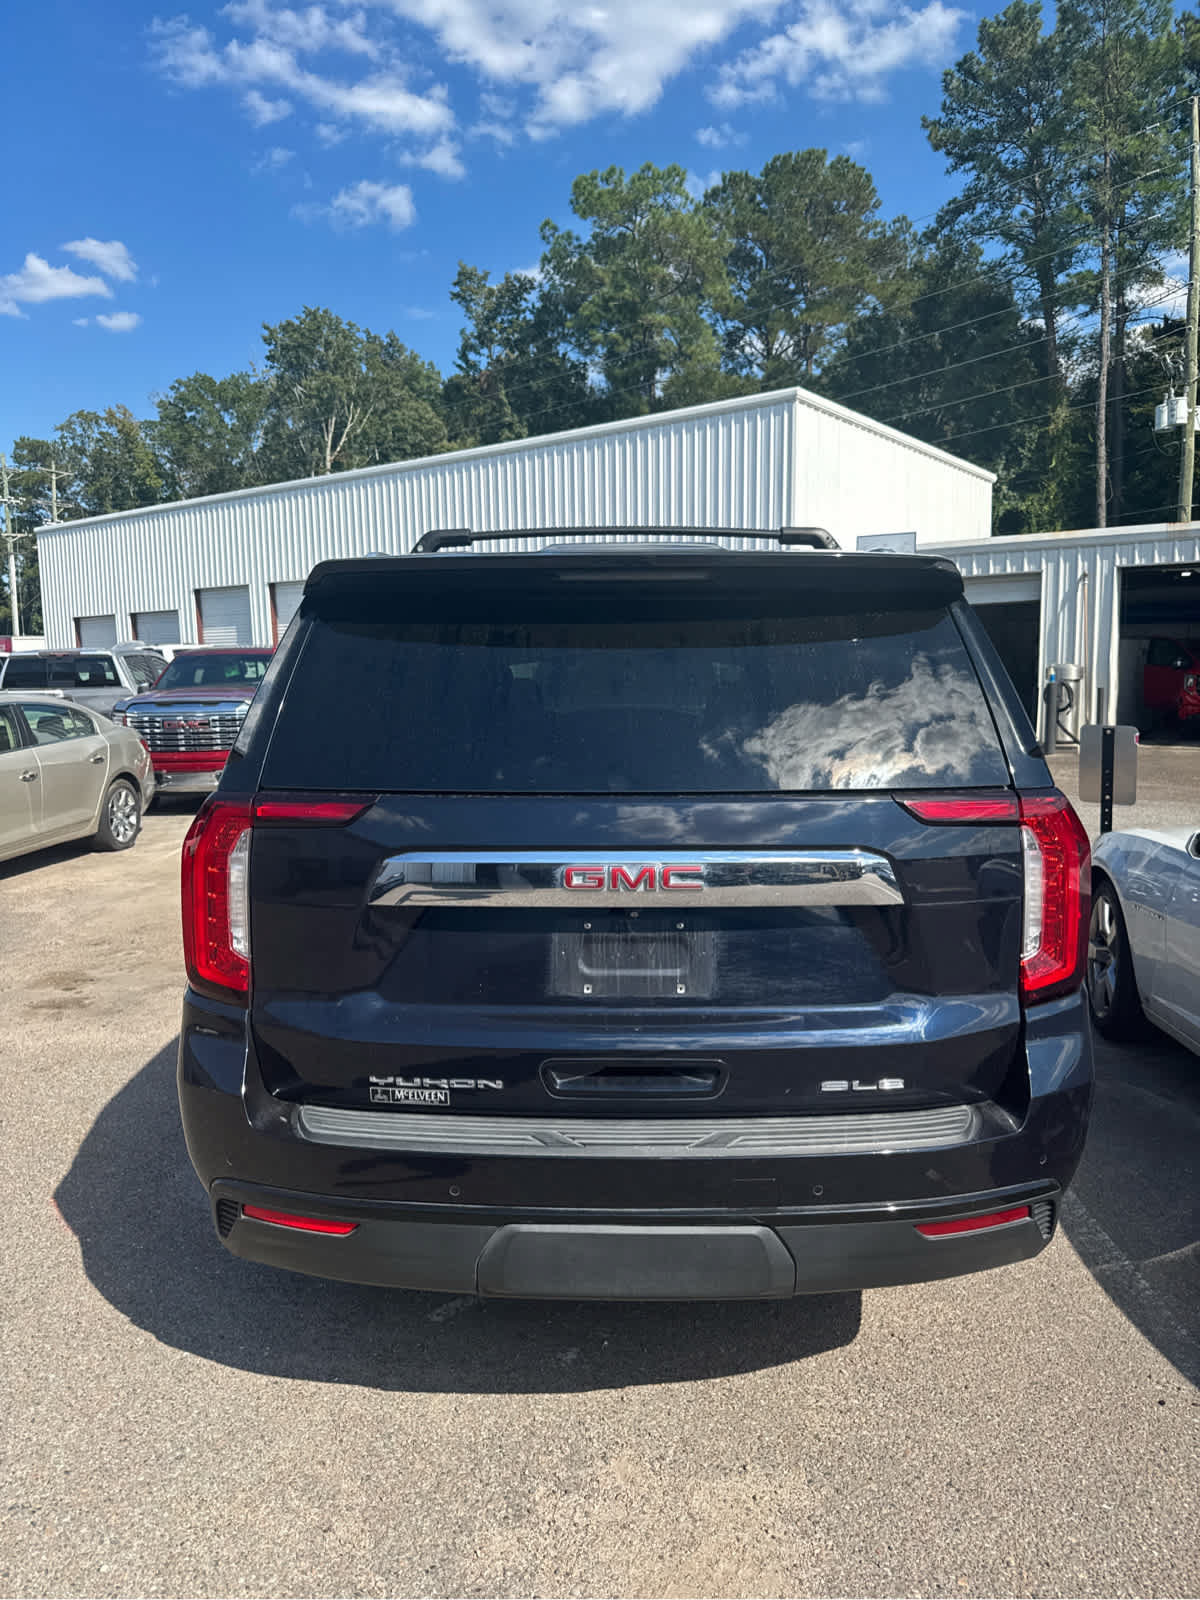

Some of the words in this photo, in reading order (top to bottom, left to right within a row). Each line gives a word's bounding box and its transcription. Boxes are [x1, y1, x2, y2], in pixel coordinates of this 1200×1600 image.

[163, 719, 209, 729] GMC
[564, 865, 704, 890] GMC
[369, 1076, 503, 1088] YUKON
